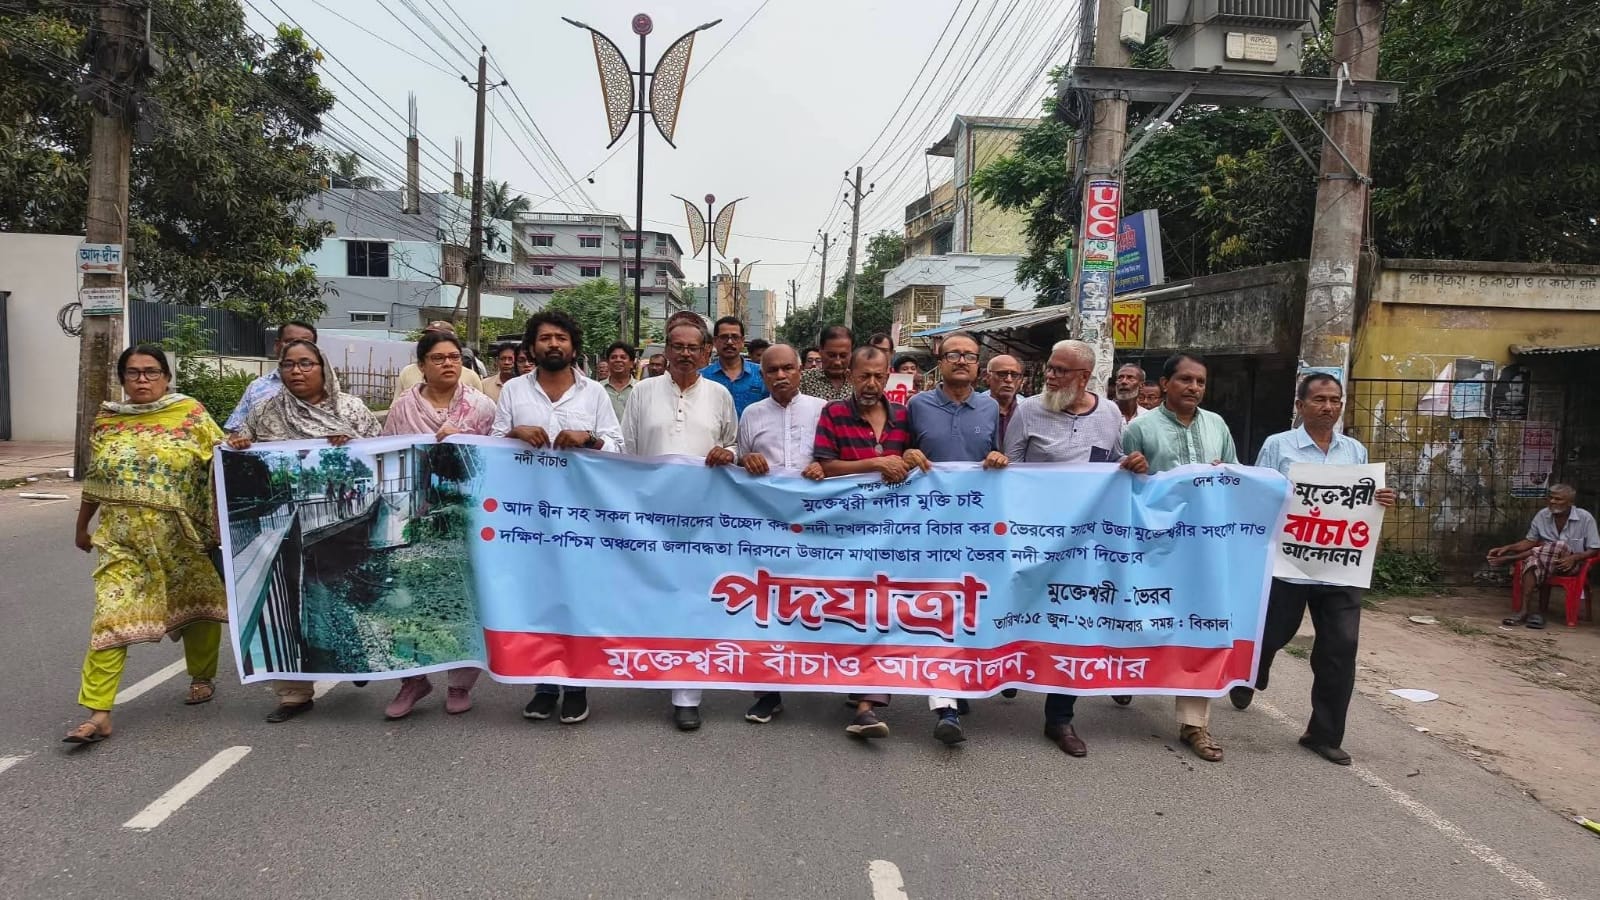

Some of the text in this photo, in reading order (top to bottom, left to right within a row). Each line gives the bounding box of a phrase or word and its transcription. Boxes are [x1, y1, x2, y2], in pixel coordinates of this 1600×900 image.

[1088, 187, 1119, 237] UCC
[514, 450, 568, 468] নদী বাঁচাও
[1193, 475, 1214, 487] দেশ
[1295, 477, 1376, 510] মুক্তেশ্বরী
[801, 490, 985, 512] মুক্তেশ্বরী নদীর মুক্তি চাই
[502, 501, 534, 516] আদ
[537, 500, 563, 519] দ্বীন
[567, 507, 590, 522] সহ
[595, 508, 631, 524] সকল
[634, 511, 715, 528] দখলদারদের
[719, 512, 763, 531] উচ্ছেদ
[804, 519, 991, 536] নদী দখলকারীদের বিচার কর
[1283, 506, 1370, 548] বাঁচাও
[1009, 520, 1066, 538] ভৈরবের
[1070, 521, 1097, 536] সাথে
[1240, 522, 1266, 536] দাও
[499, 527, 596, 549] দক্ষিণ-পশ্চিম
[600, 536, 657, 553] অঞ্চলের
[661, 540, 732, 556] জলাবদ্ধতা
[737, 539, 793, 558] নিরসনে
[797, 542, 846, 561] উজানে
[848, 547, 922, 563] মাথাভাঙার
[927, 547, 963, 563] সাথে
[967, 546, 1007, 563] ভৈরব
[1011, 546, 1040, 563] নদী
[1043, 546, 1089, 562] সংযোগ
[1282, 542, 1362, 567] আন্দোলন
[710, 568, 990, 641] পদযাত্রা
[1047, 580, 1119, 605] মুক্তেশ্বরী
[1097, 616, 1143, 632] সোমবার
[1150, 617, 1175, 630] সময়
[1189, 613, 1229, 631] বিকাল
[603, 641, 1151, 685] মুক্তেশ্বরী বাঁচাও আন্দোলন, যশোর
